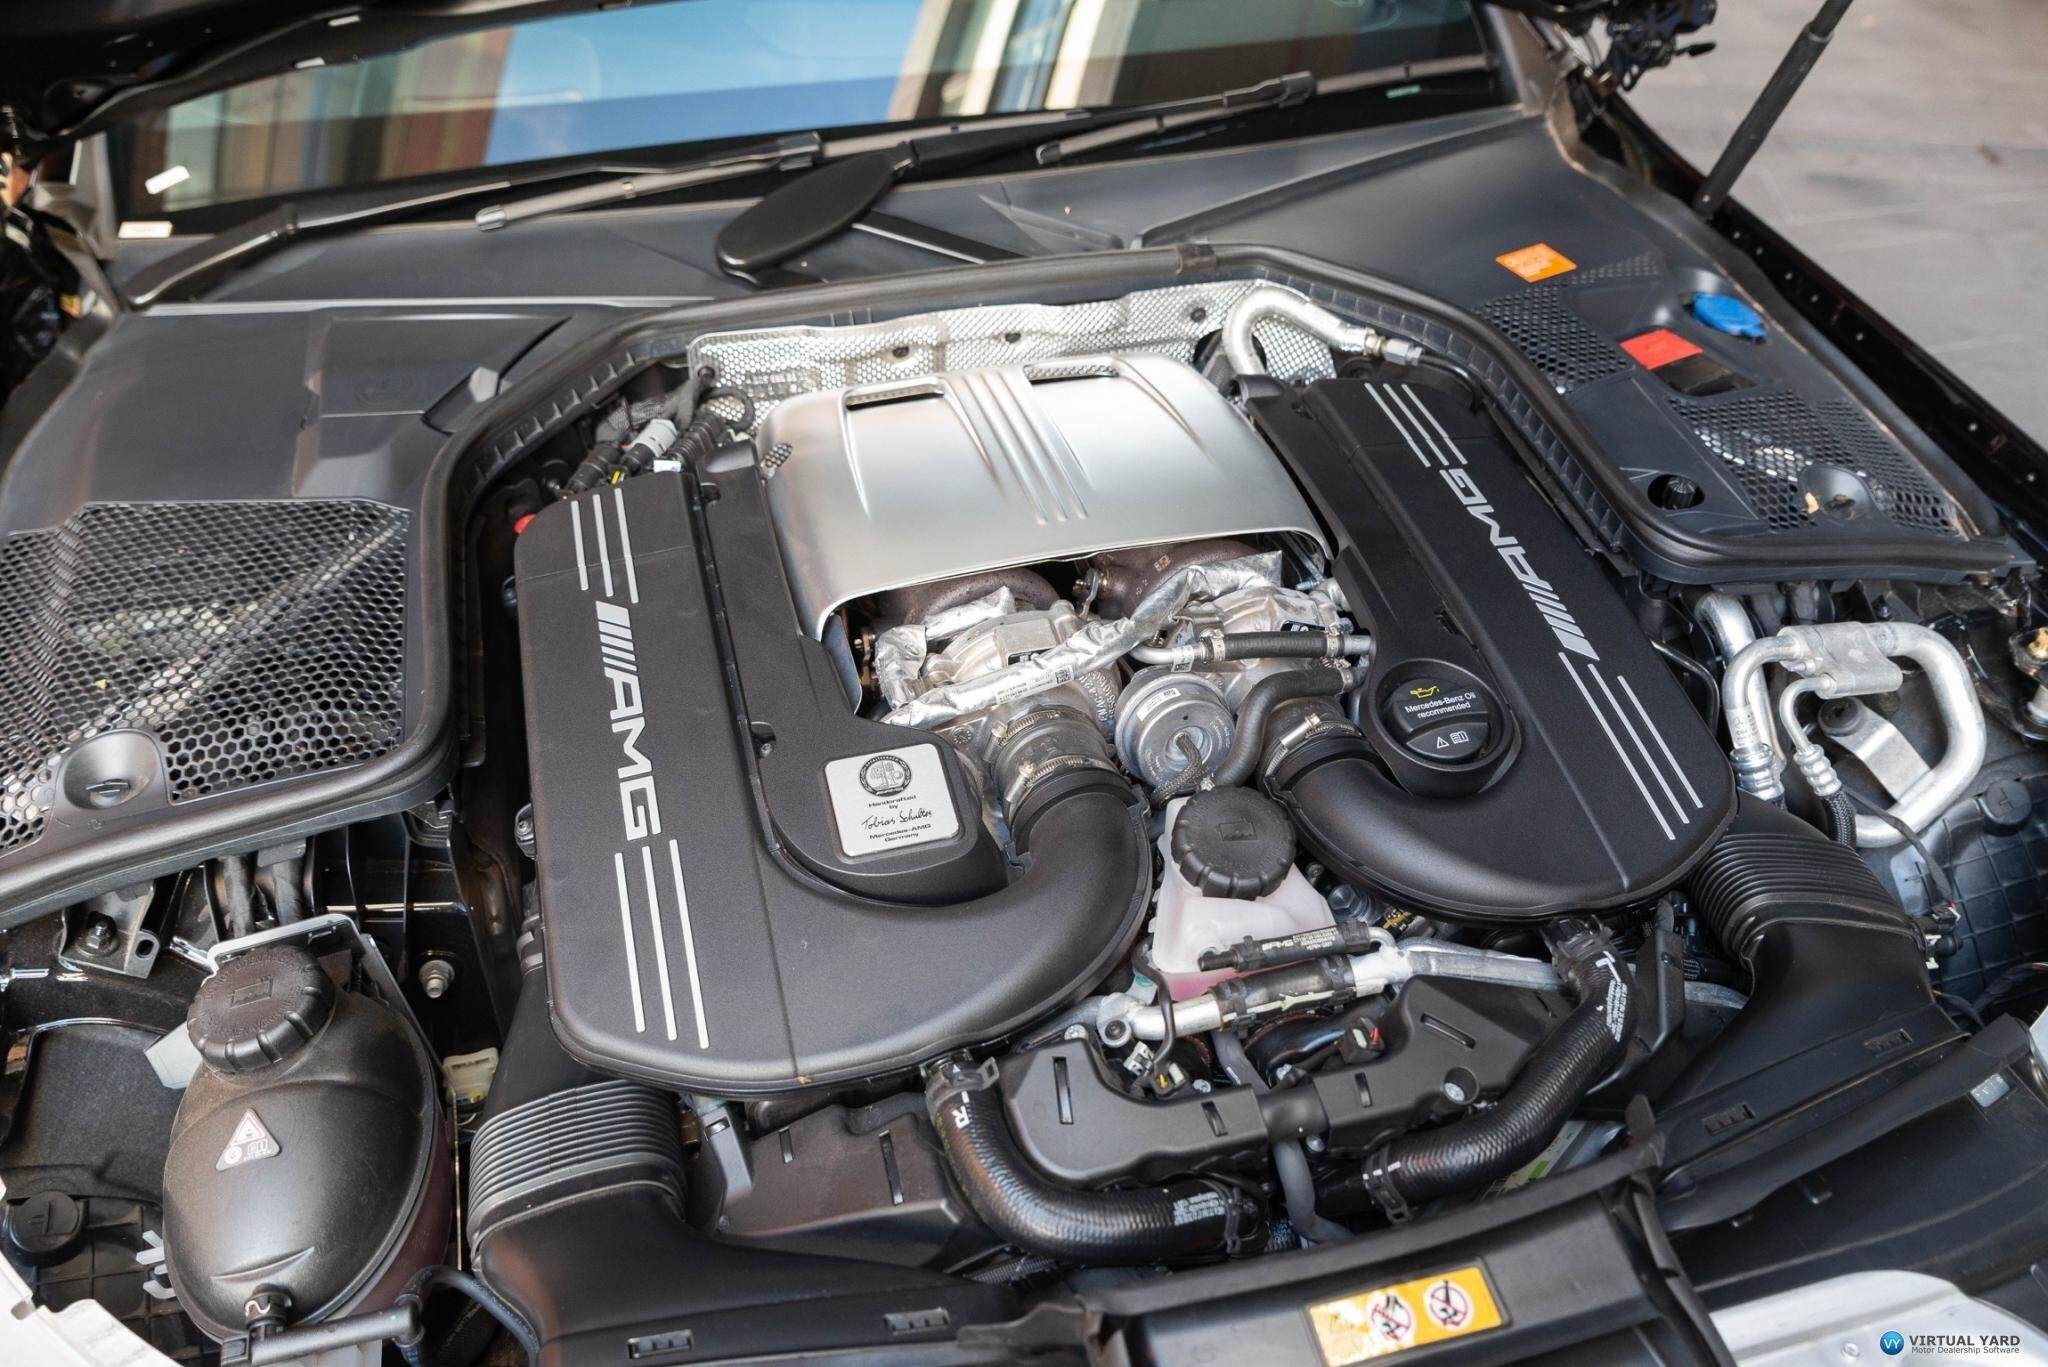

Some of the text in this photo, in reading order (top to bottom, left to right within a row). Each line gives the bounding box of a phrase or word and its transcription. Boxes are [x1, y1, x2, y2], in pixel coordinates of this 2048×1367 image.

[1439, 468, 1553, 591] AMG
[1405, 692, 1476, 713] Mercedes-Benz Oil
[1418, 702, 1471, 718] recommended
[603, 666, 662, 841] AMG
[868, 795, 916, 807] Handcrafted
[869, 823, 932, 840] Mercedes-AMG
[884, 832, 919, 842] Germany
